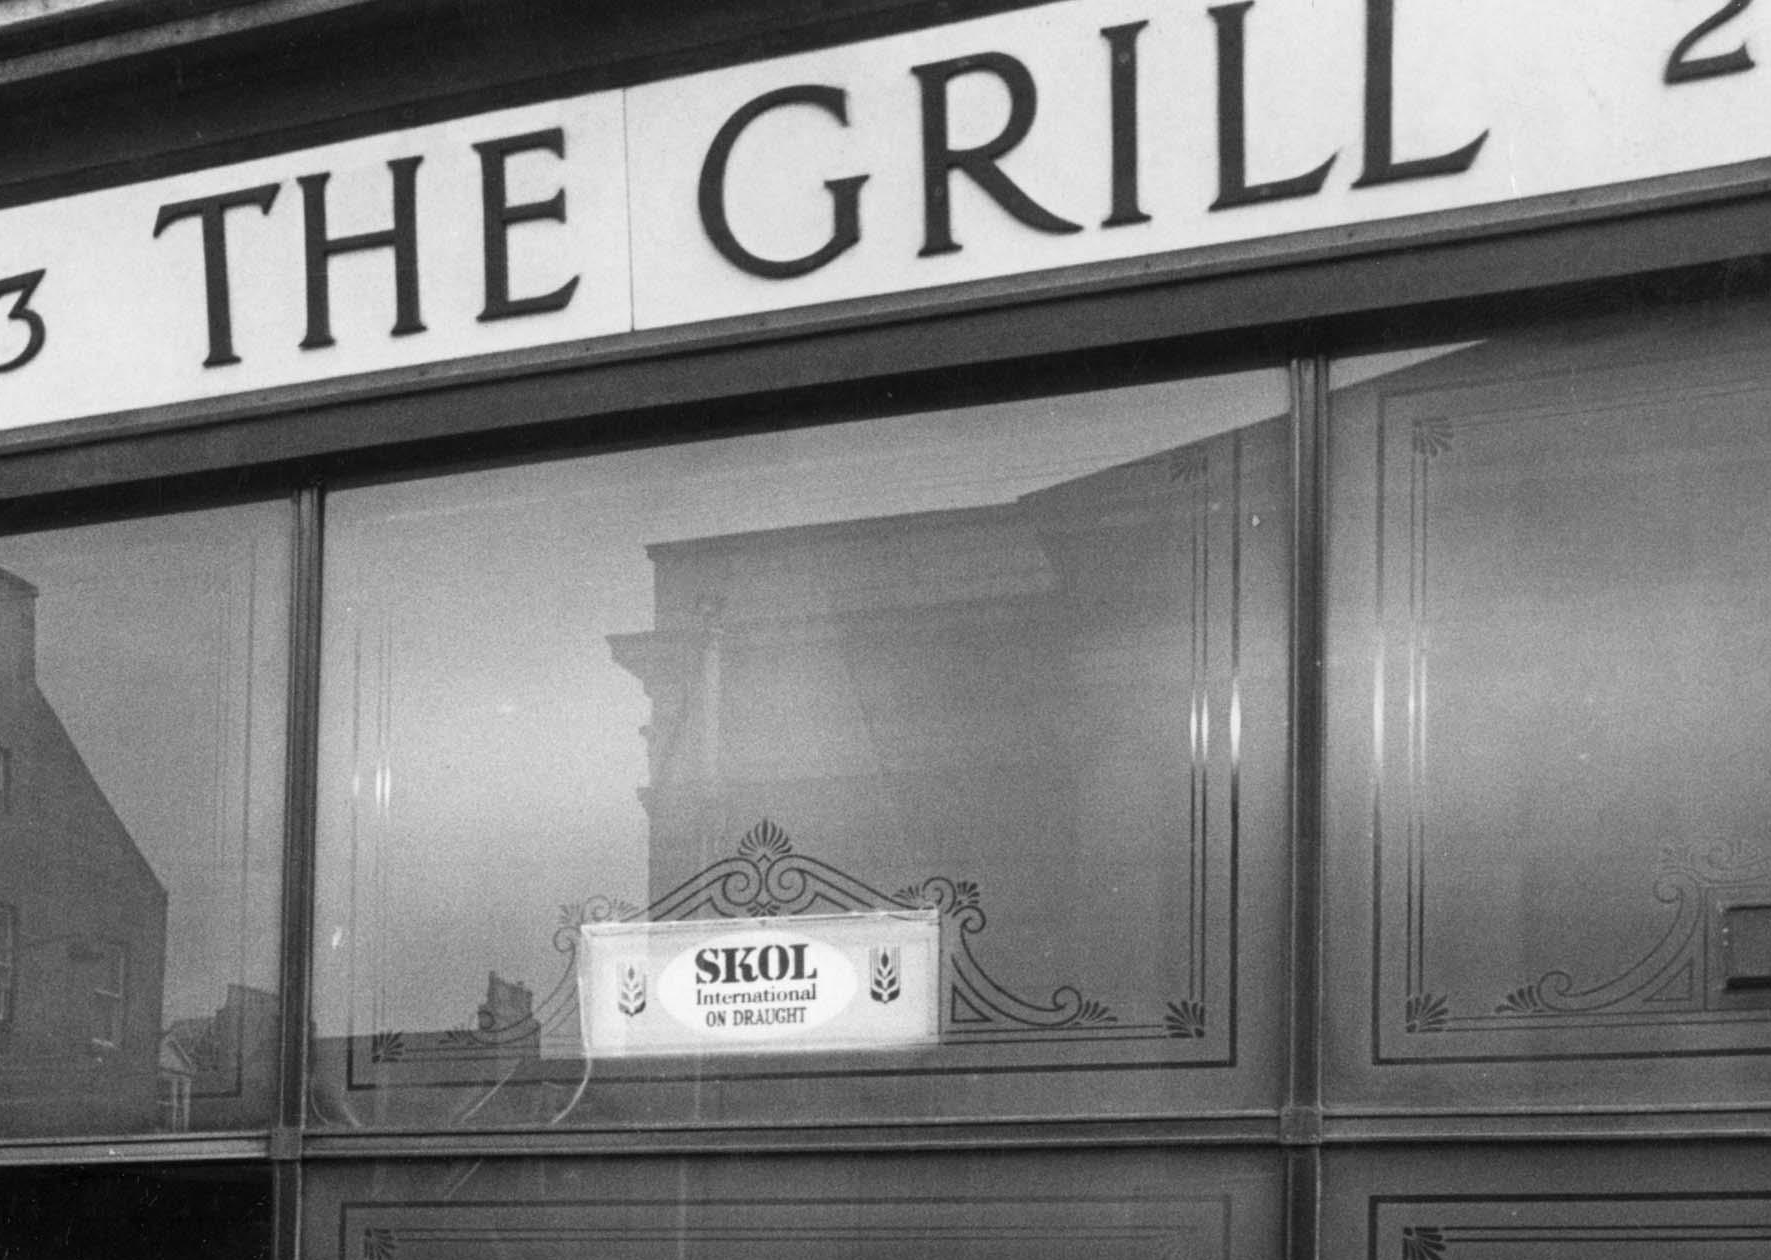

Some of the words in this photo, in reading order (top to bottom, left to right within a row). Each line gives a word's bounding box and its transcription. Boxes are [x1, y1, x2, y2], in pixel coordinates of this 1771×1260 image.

[153, 127, 581, 369] THE
[697, 0, 1491, 280] GRILL
[694, 943, 818, 984] SKOL
[695, 983, 817, 1006] International
[706, 1010, 726, 1027] ON
[732, 1006, 807, 1026] DRAUGHT
